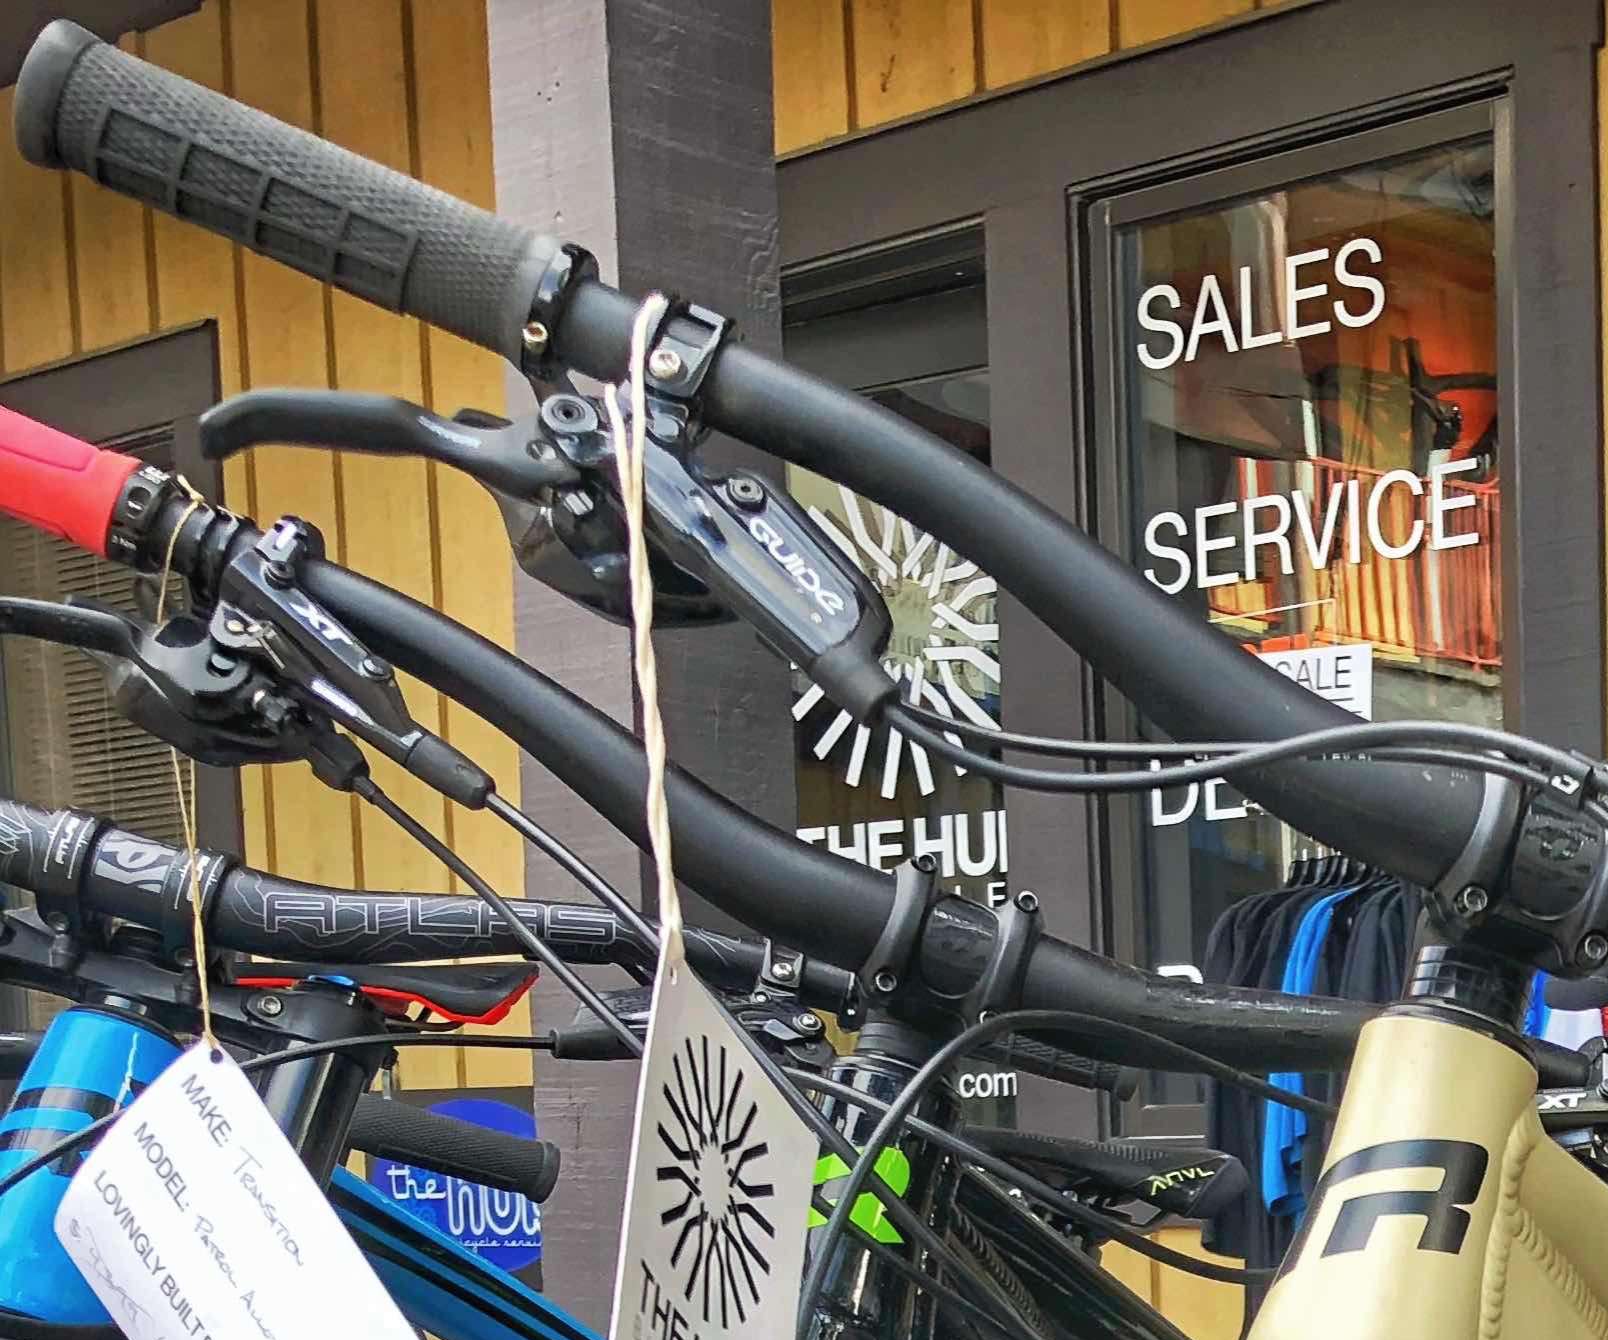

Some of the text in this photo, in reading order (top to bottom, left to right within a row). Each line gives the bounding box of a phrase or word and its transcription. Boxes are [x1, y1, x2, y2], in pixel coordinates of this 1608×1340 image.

[1136, 237, 1386, 369] SALES
[749, 516, 844, 616] GUIDE
[1144, 457, 1480, 595] SERVICE
[912, 809, 1009, 878] HU
[263, 890, 618, 943] ATLAS
[181, 1073, 232, 1148] MAKE:
[1536, 1091, 1588, 1110] XT
[133, 1120, 190, 1213] MODEL:
[386, 1164, 447, 1200] the
[94, 1170, 166, 1276] LOVINGLY
[160, 1273, 206, 1338] BUILT
